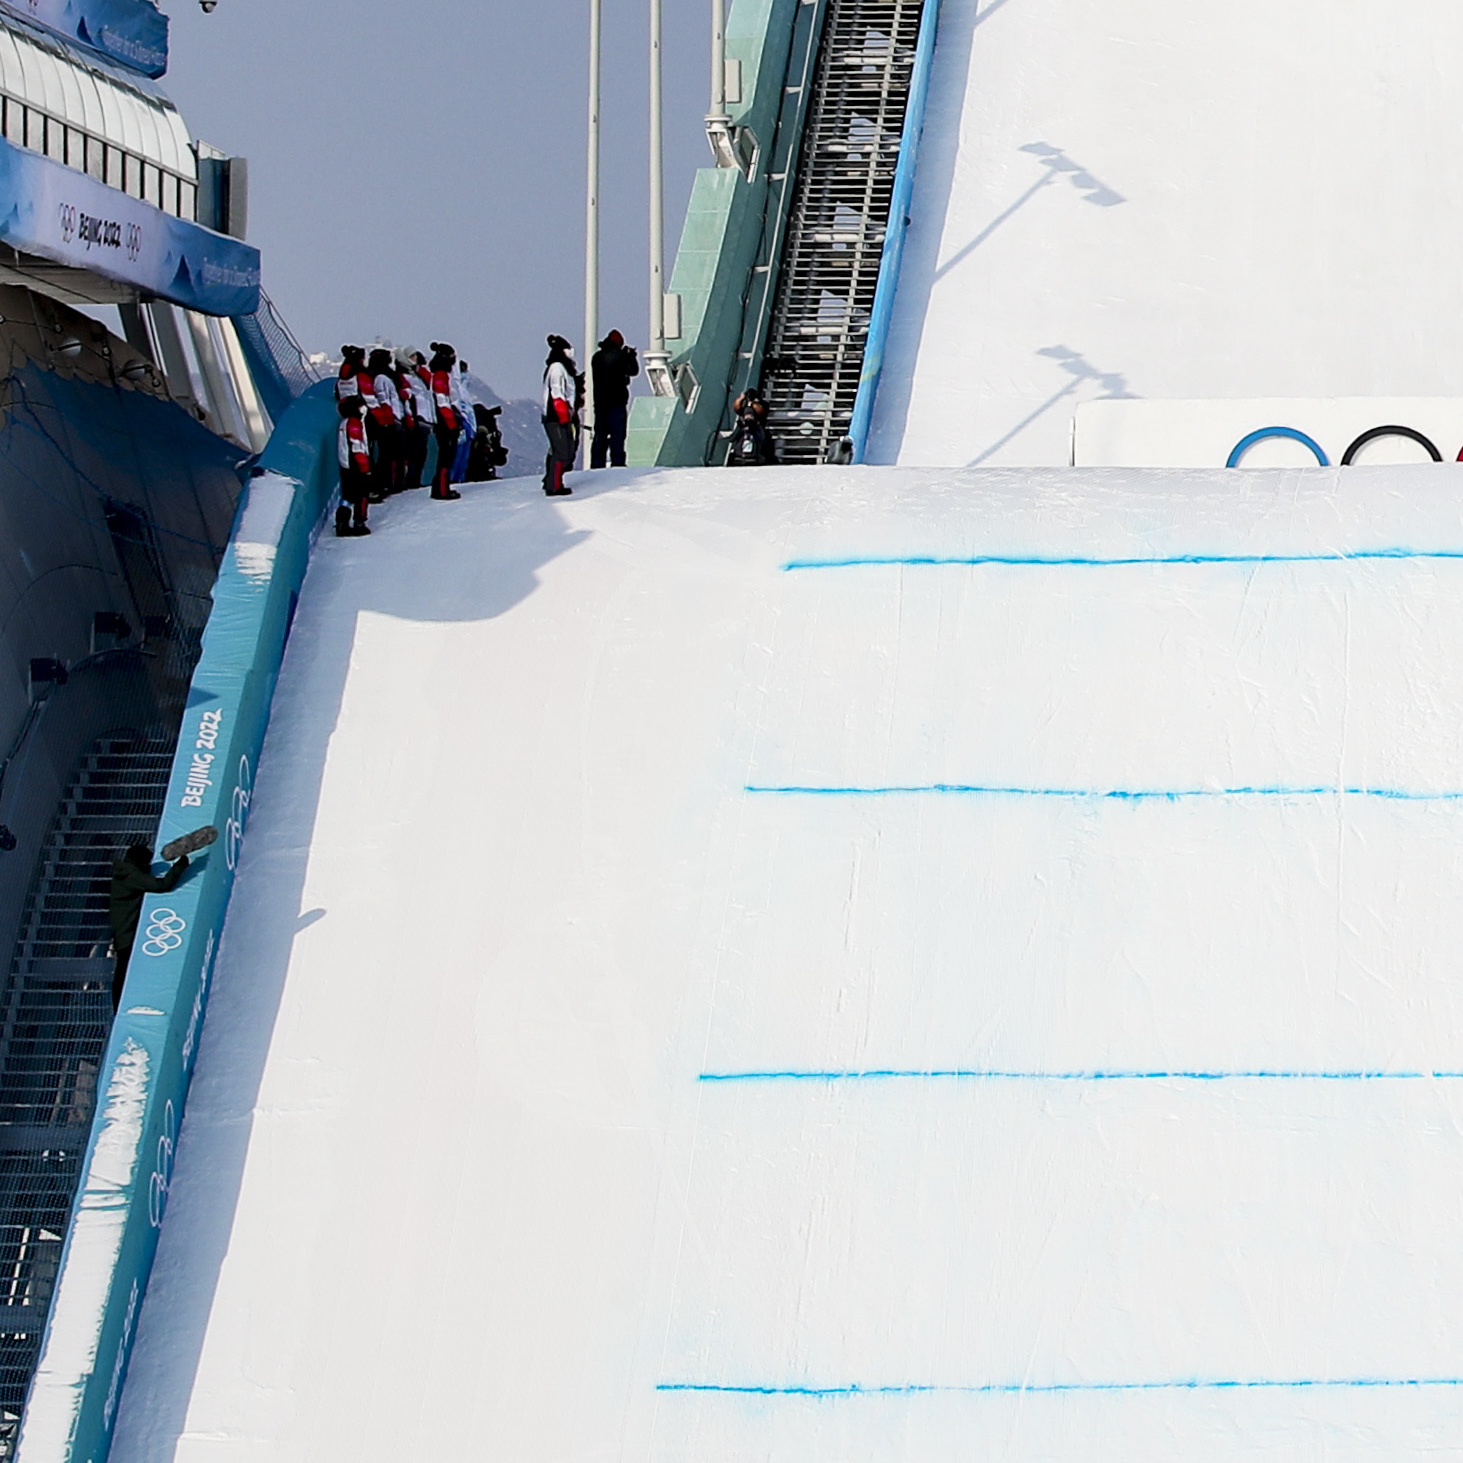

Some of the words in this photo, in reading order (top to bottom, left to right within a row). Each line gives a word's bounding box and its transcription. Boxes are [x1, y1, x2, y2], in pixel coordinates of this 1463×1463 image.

[79, 212, 102, 251] BEIJING
[196, 707, 223, 750] 2022
[180, 753, 215, 807] BEIJING
